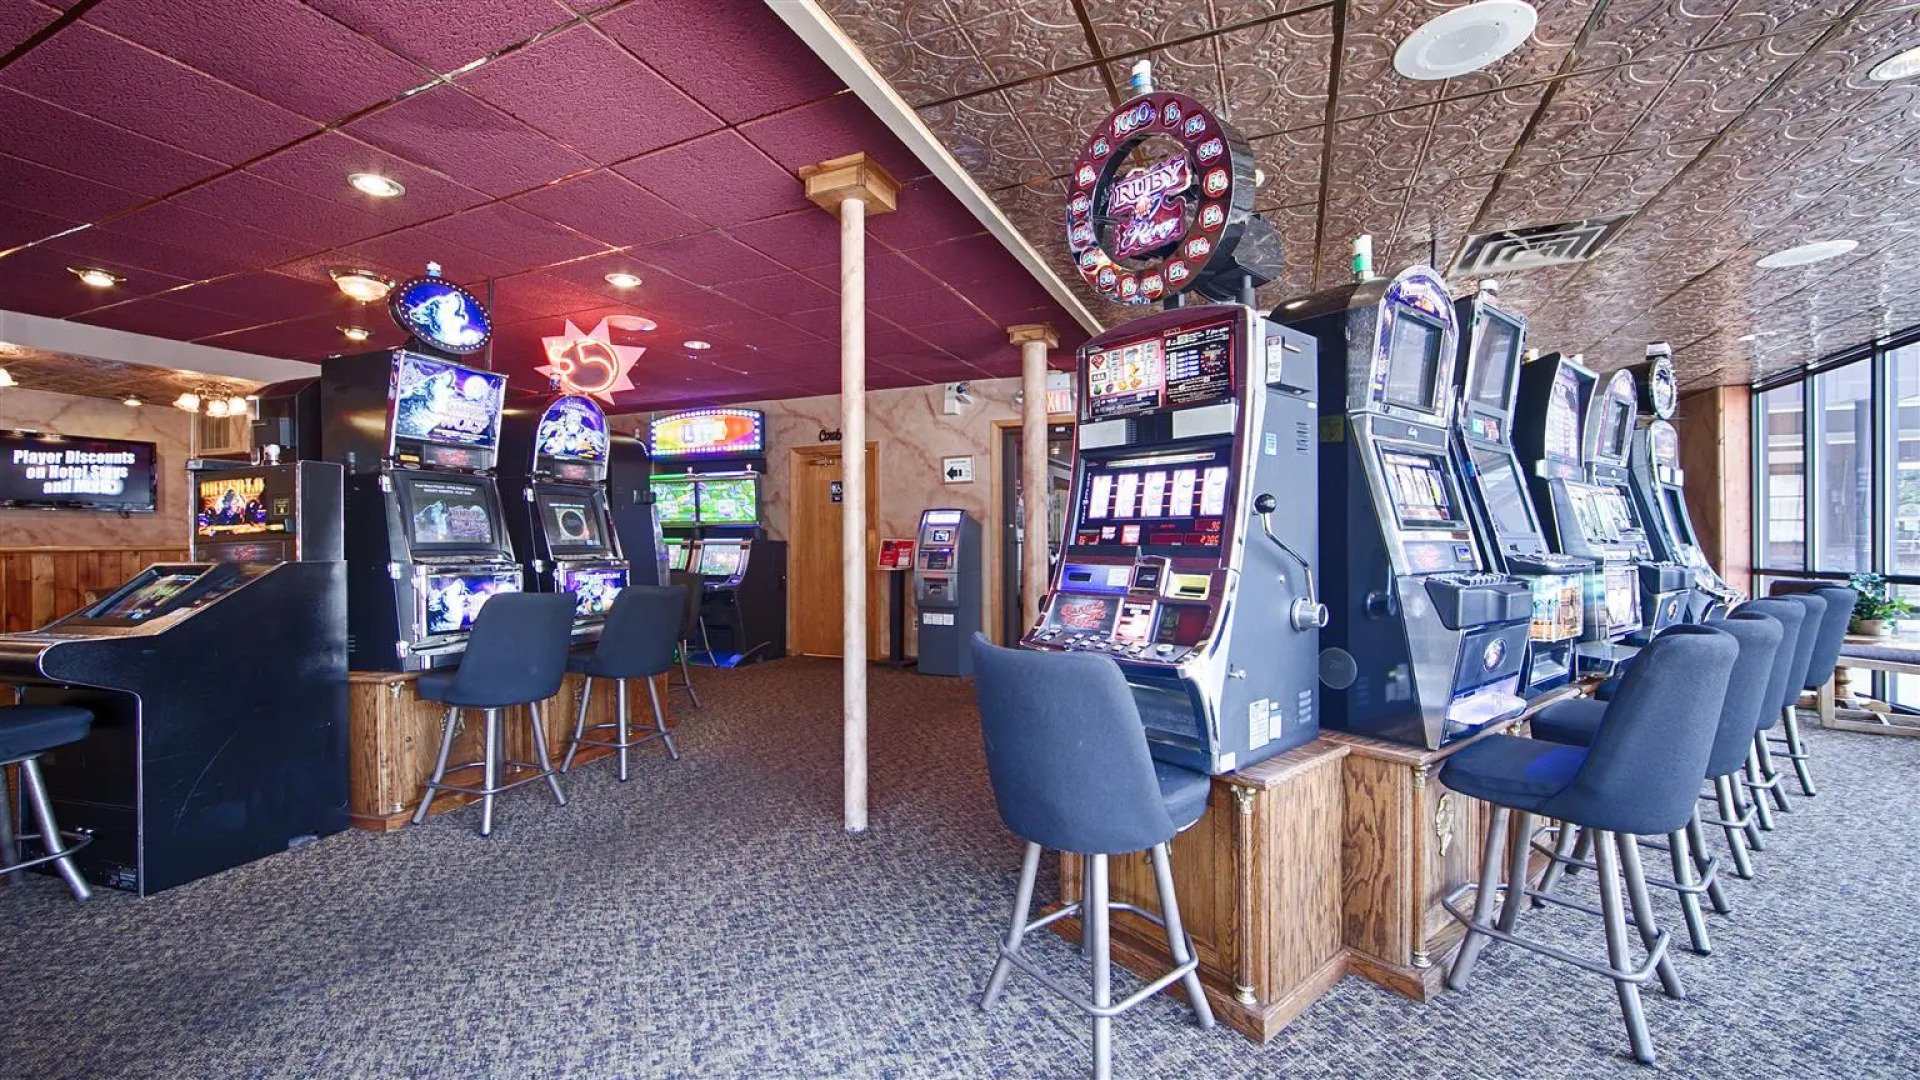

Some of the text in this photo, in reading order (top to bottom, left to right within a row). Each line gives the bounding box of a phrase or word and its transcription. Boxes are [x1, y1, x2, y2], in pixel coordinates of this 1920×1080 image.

[1113, 159, 1185, 208] RUBY
[1121, 219, 1179, 250] King
[1045, 390, 1069, 411] XIT
[13, 449, 136, 466] Player Discounts
[25, 464, 129, 481] on Hotel Stays
[43, 479, 71, 494] and
